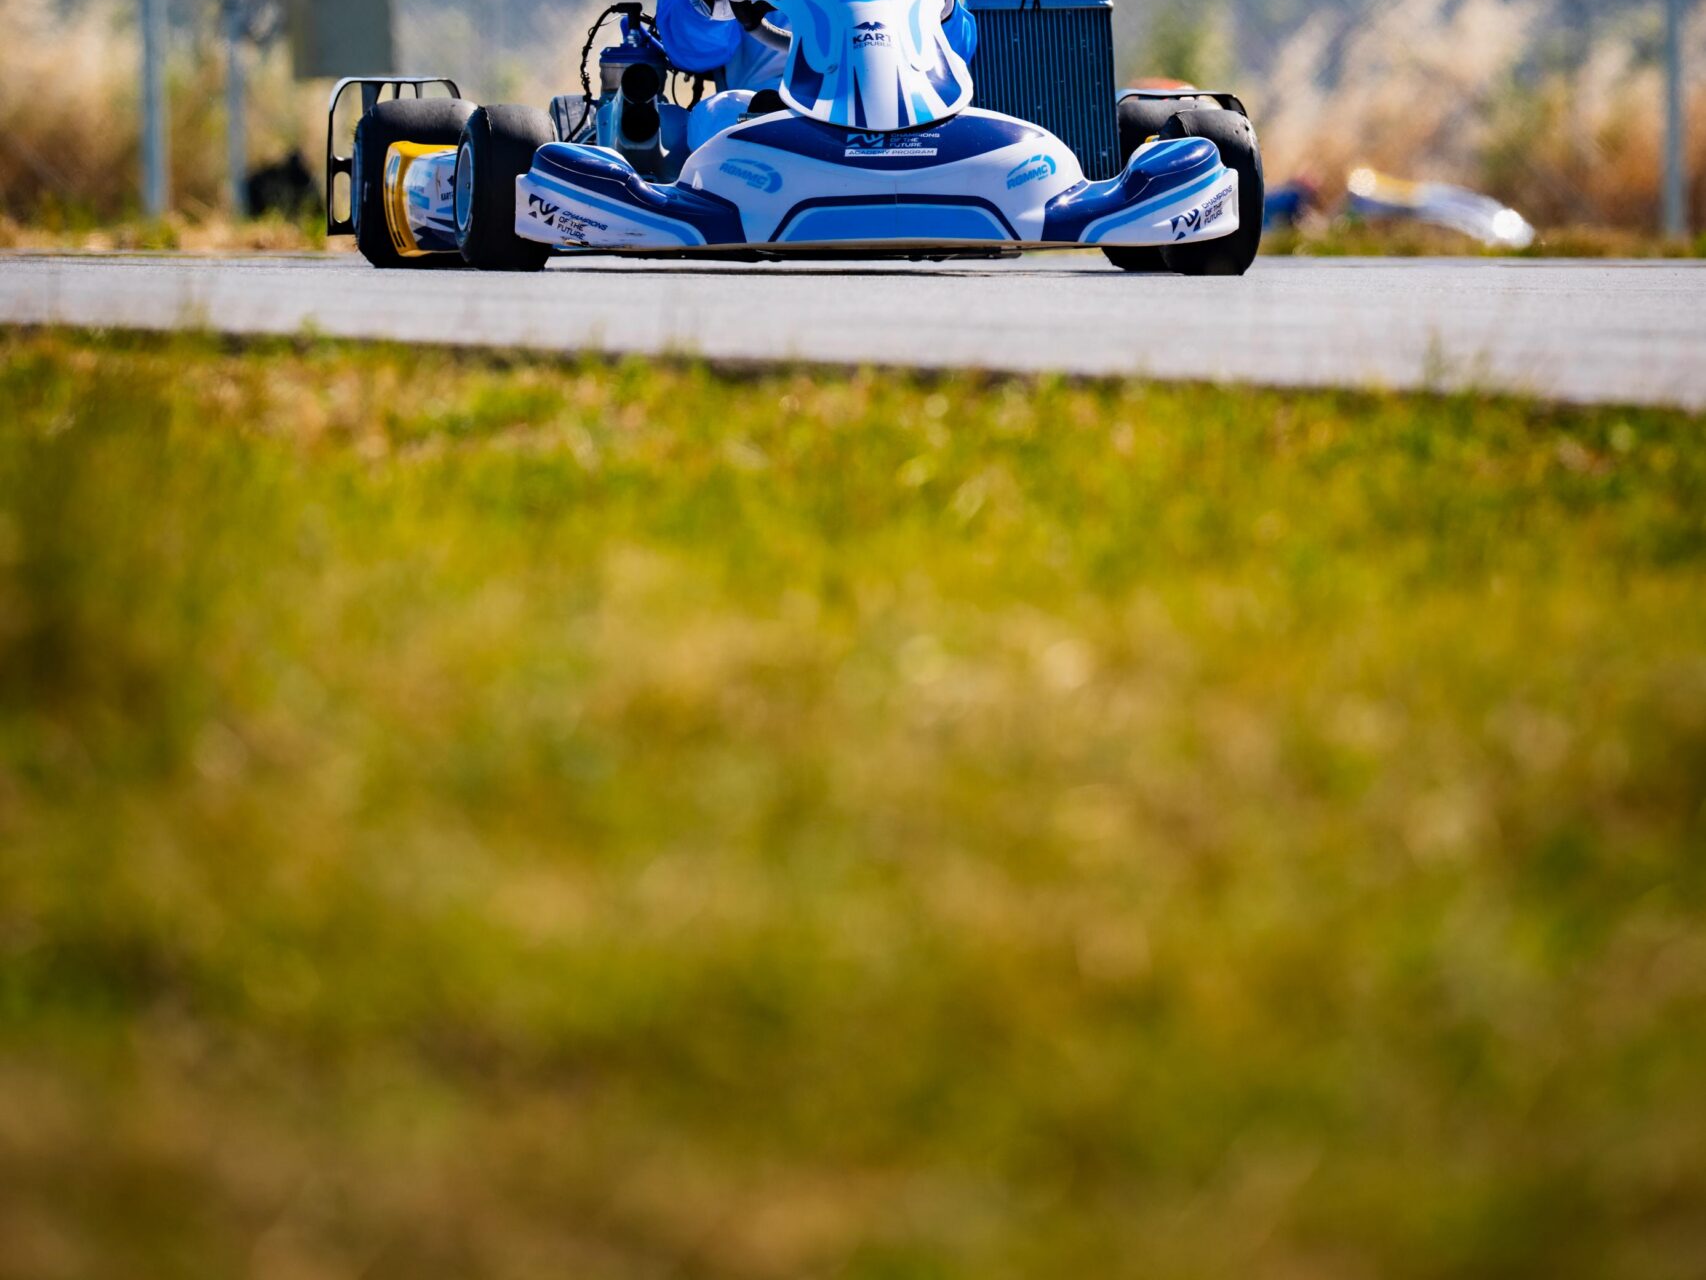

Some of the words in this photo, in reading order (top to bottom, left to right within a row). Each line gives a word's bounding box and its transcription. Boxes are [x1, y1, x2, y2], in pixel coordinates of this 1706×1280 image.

[852, 33, 891, 44] KART
[1201, 185, 1232, 208] CHAMPIONS
[1204, 208, 1223, 226] FUTURE
[1205, 207, 1213, 217] OF
[559, 216, 569, 224] OF
[571, 221, 586, 232] THE
[562, 211, 608, 231] CHAMPIONS
[557, 224, 586, 240] FUTURE
